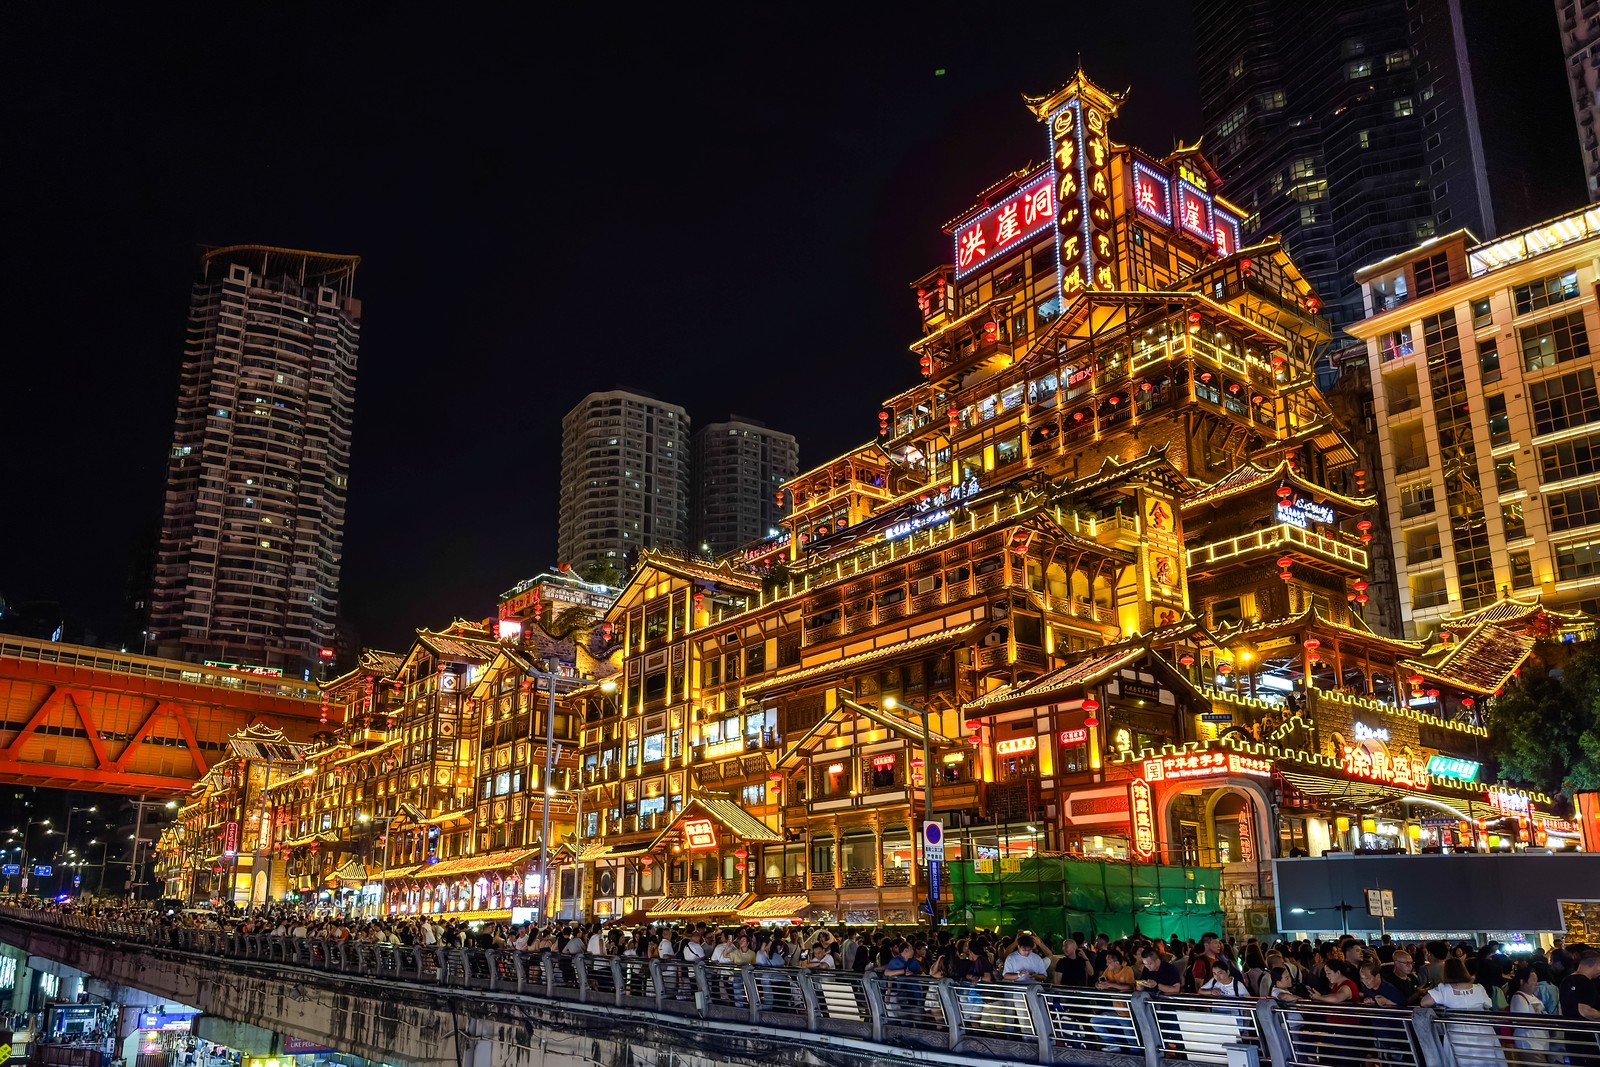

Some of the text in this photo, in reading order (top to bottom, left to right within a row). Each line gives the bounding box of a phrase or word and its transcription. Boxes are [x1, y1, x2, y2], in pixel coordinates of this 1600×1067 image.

[959, 185, 1054, 268] 洪崖洞
[1164, 753, 1225, 770] 中华老字号
[1240, 757, 1271, 772] 中华老字号
